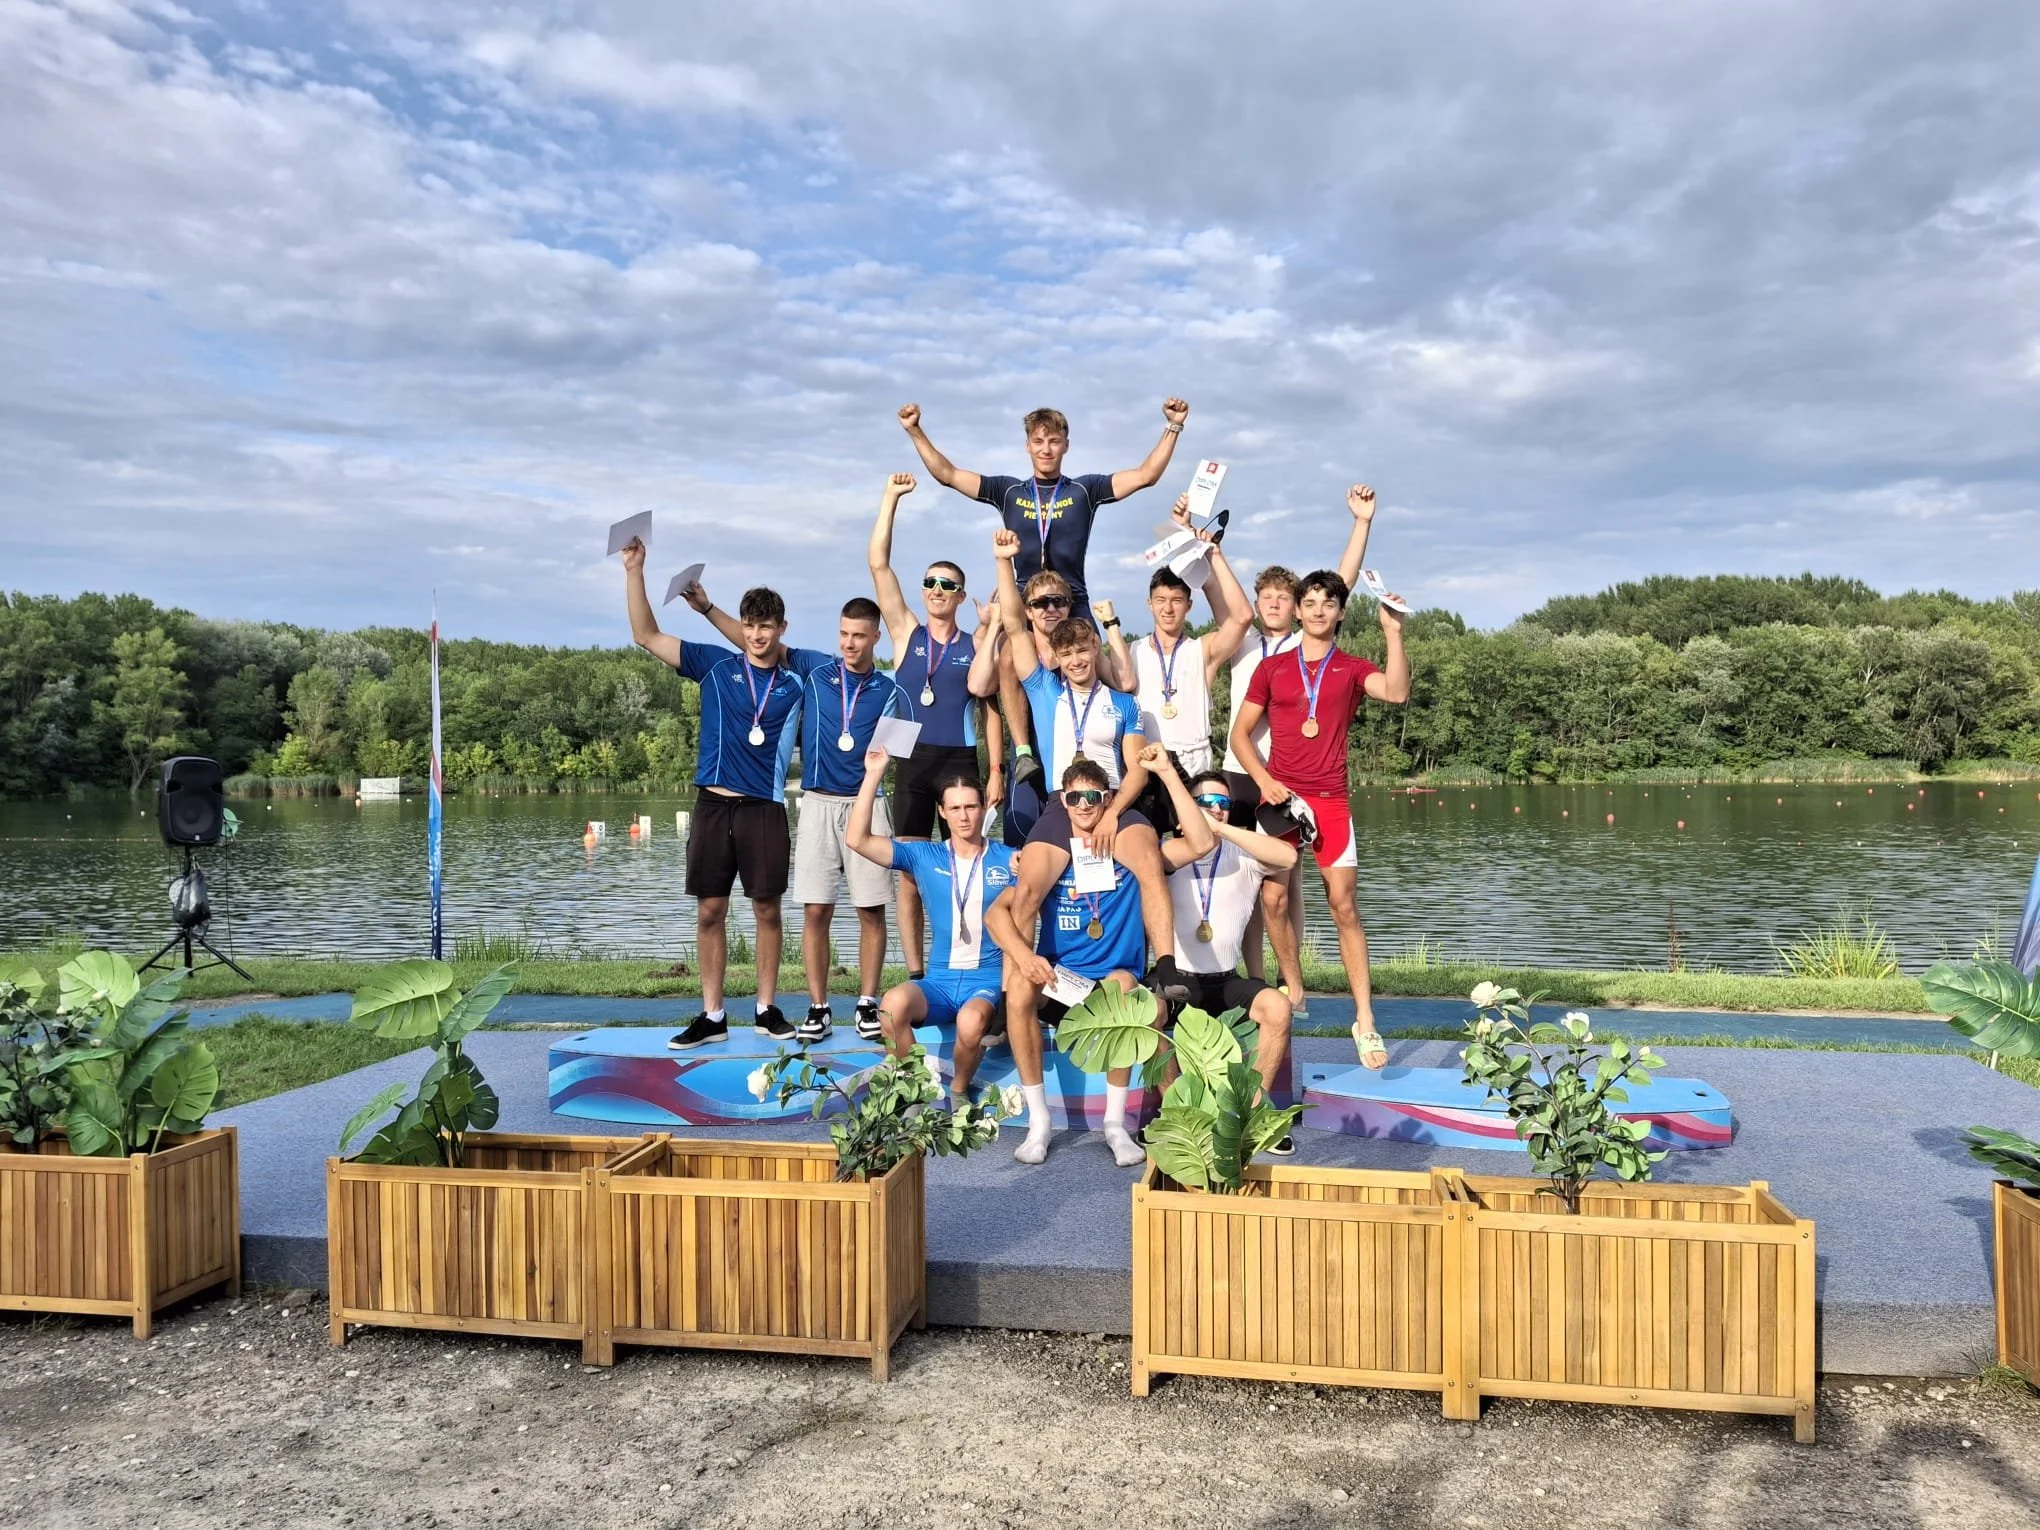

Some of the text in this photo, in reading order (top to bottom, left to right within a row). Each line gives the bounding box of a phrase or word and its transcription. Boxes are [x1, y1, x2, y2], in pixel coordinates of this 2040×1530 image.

[1016, 497, 1074, 510] KAJA-KNOE
[1077, 854, 1110, 864] DIPL
[1061, 917, 1078, 928] IN
